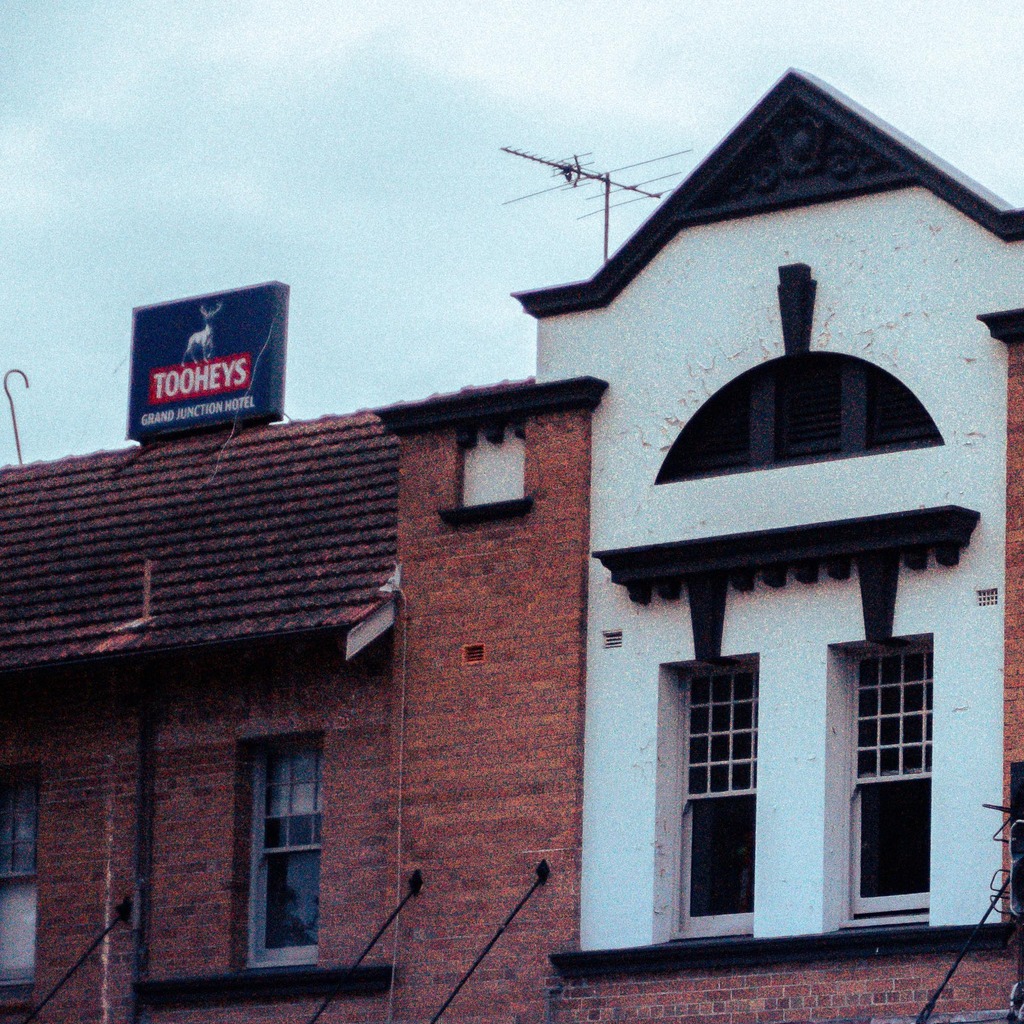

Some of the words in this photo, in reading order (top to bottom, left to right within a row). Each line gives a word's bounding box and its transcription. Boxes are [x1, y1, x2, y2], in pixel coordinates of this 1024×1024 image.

[153, 358, 248, 399] TOOHEYS
[141, 409, 174, 426] GRAND
[176, 402, 222, 420] JUNCTION
[224, 396, 255, 411] HOTEL
